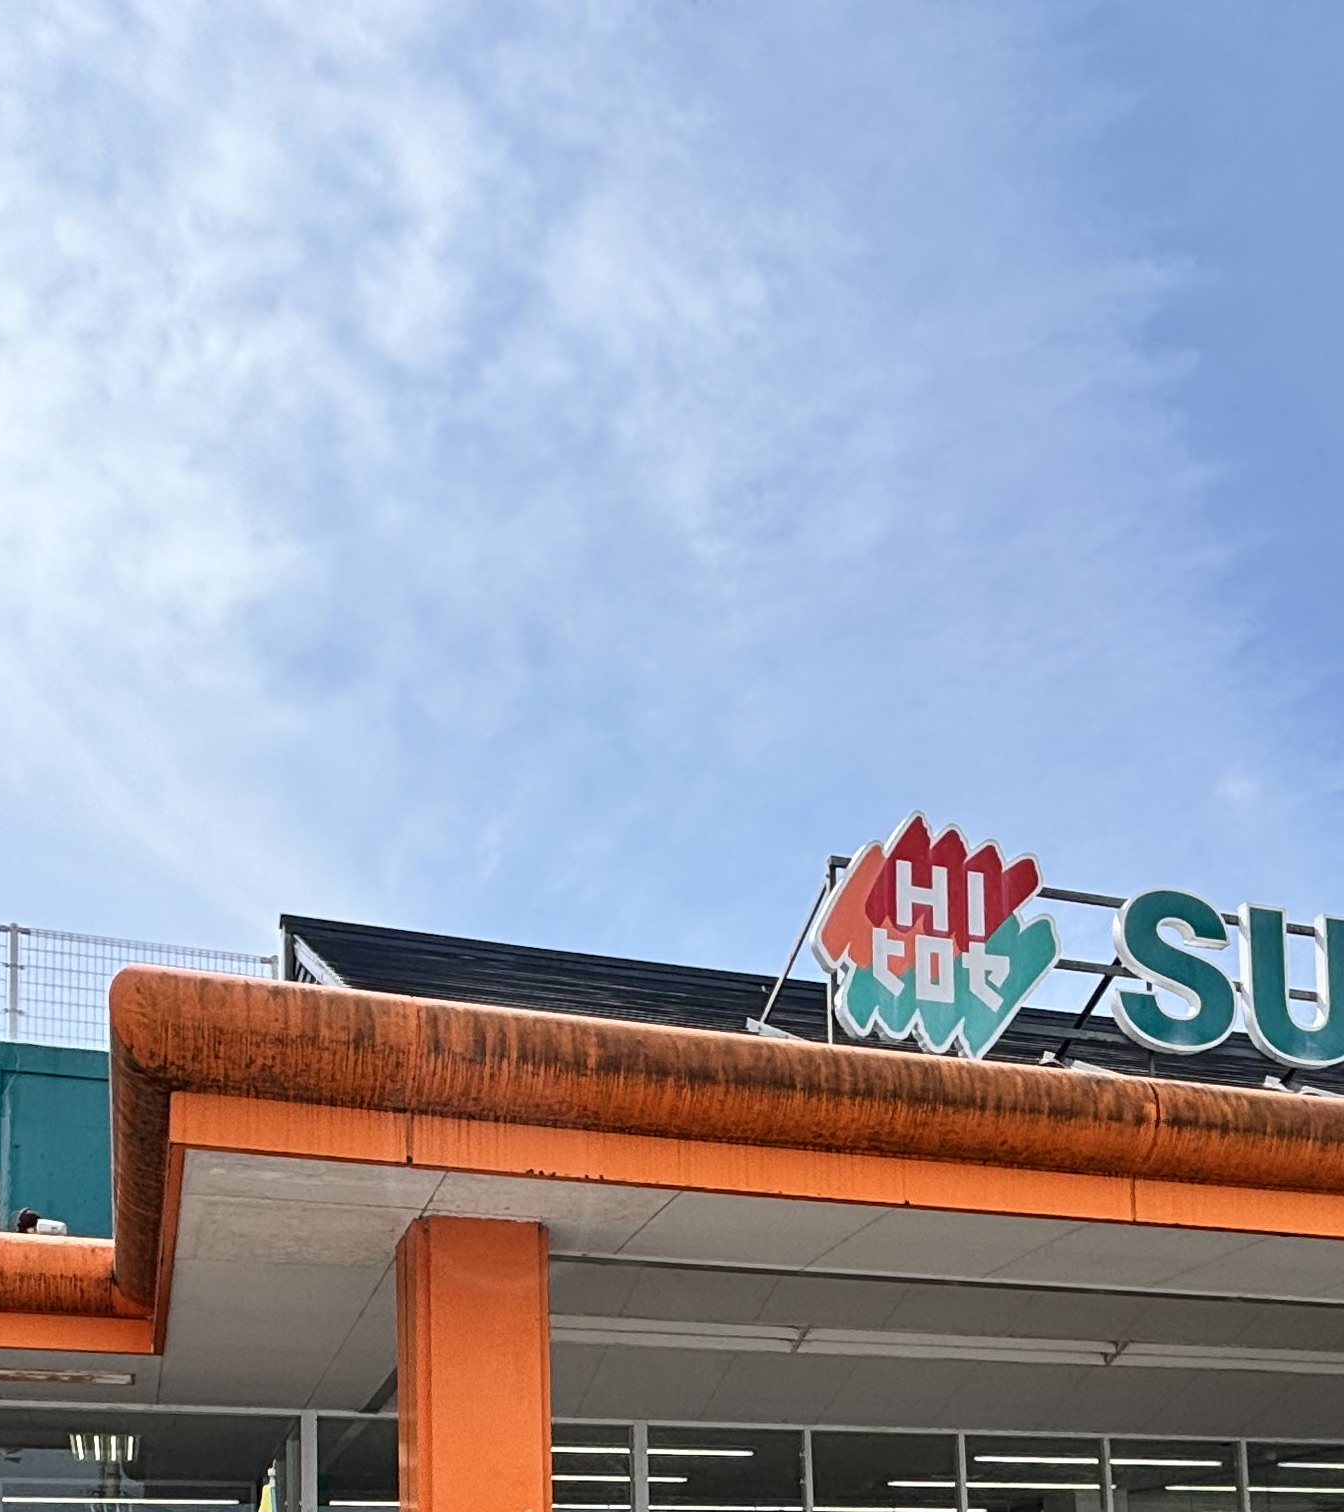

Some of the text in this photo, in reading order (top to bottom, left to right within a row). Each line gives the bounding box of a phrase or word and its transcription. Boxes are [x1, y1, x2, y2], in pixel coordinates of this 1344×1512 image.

[896, 860, 985, 936] HI
[872, 927, 1010, 1014] ヒロセ
